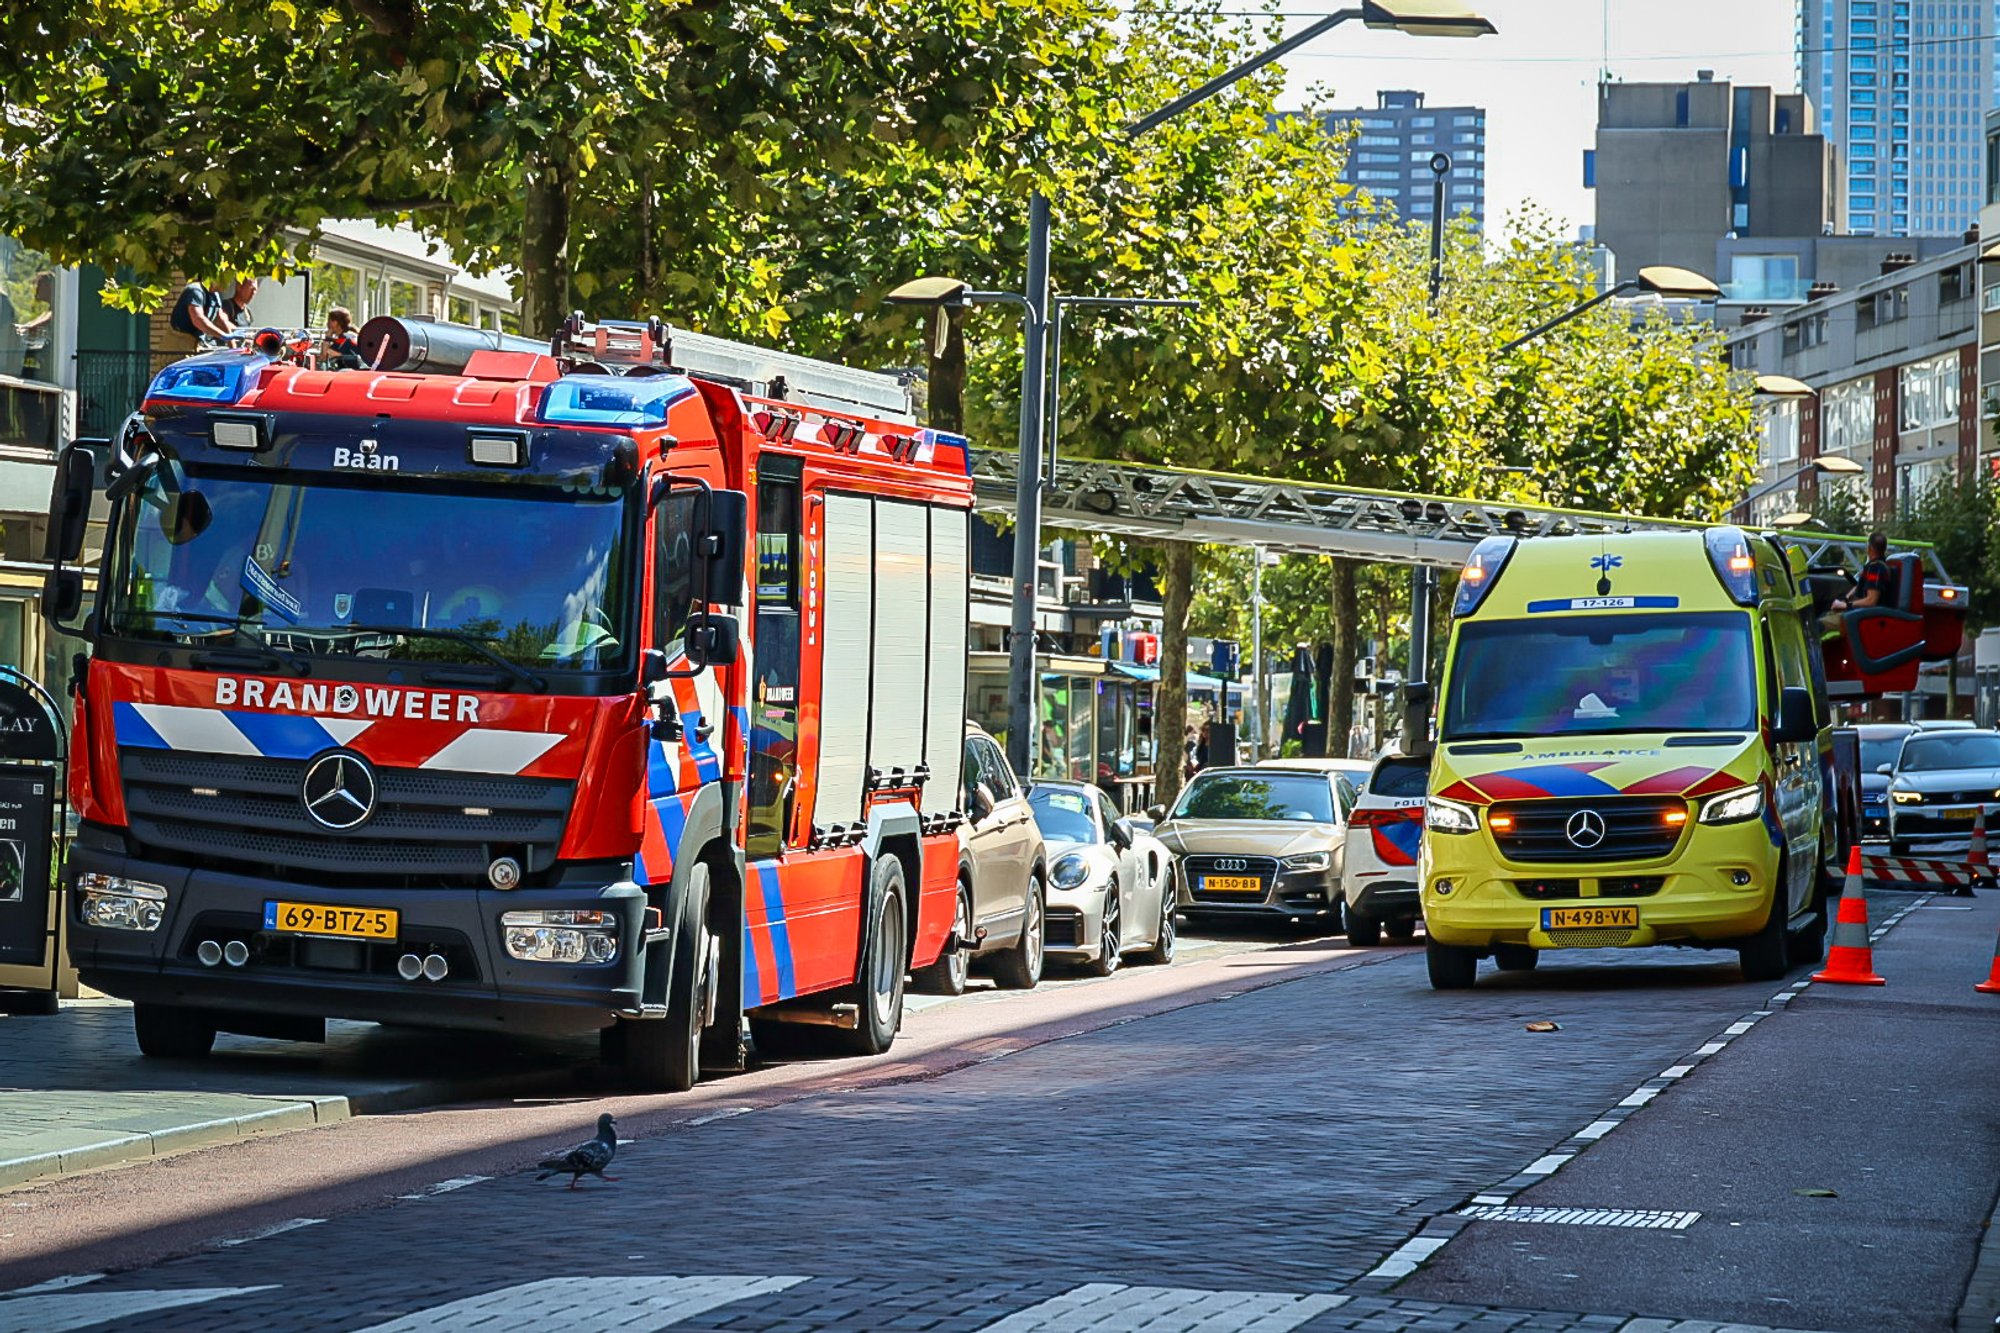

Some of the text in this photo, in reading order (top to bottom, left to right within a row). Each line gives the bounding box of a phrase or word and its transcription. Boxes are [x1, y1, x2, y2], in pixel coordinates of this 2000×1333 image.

[333, 447, 399, 471] Baan
[1581, 599, 1625, 608] 17-126
[216, 677, 480, 723] BRANDWEER
[1522, 749, 1661, 761] AMBULANCE
[285, 907, 388, 934] 69-BTZ-5
[1554, 909, 1632, 926] N-498-VK
